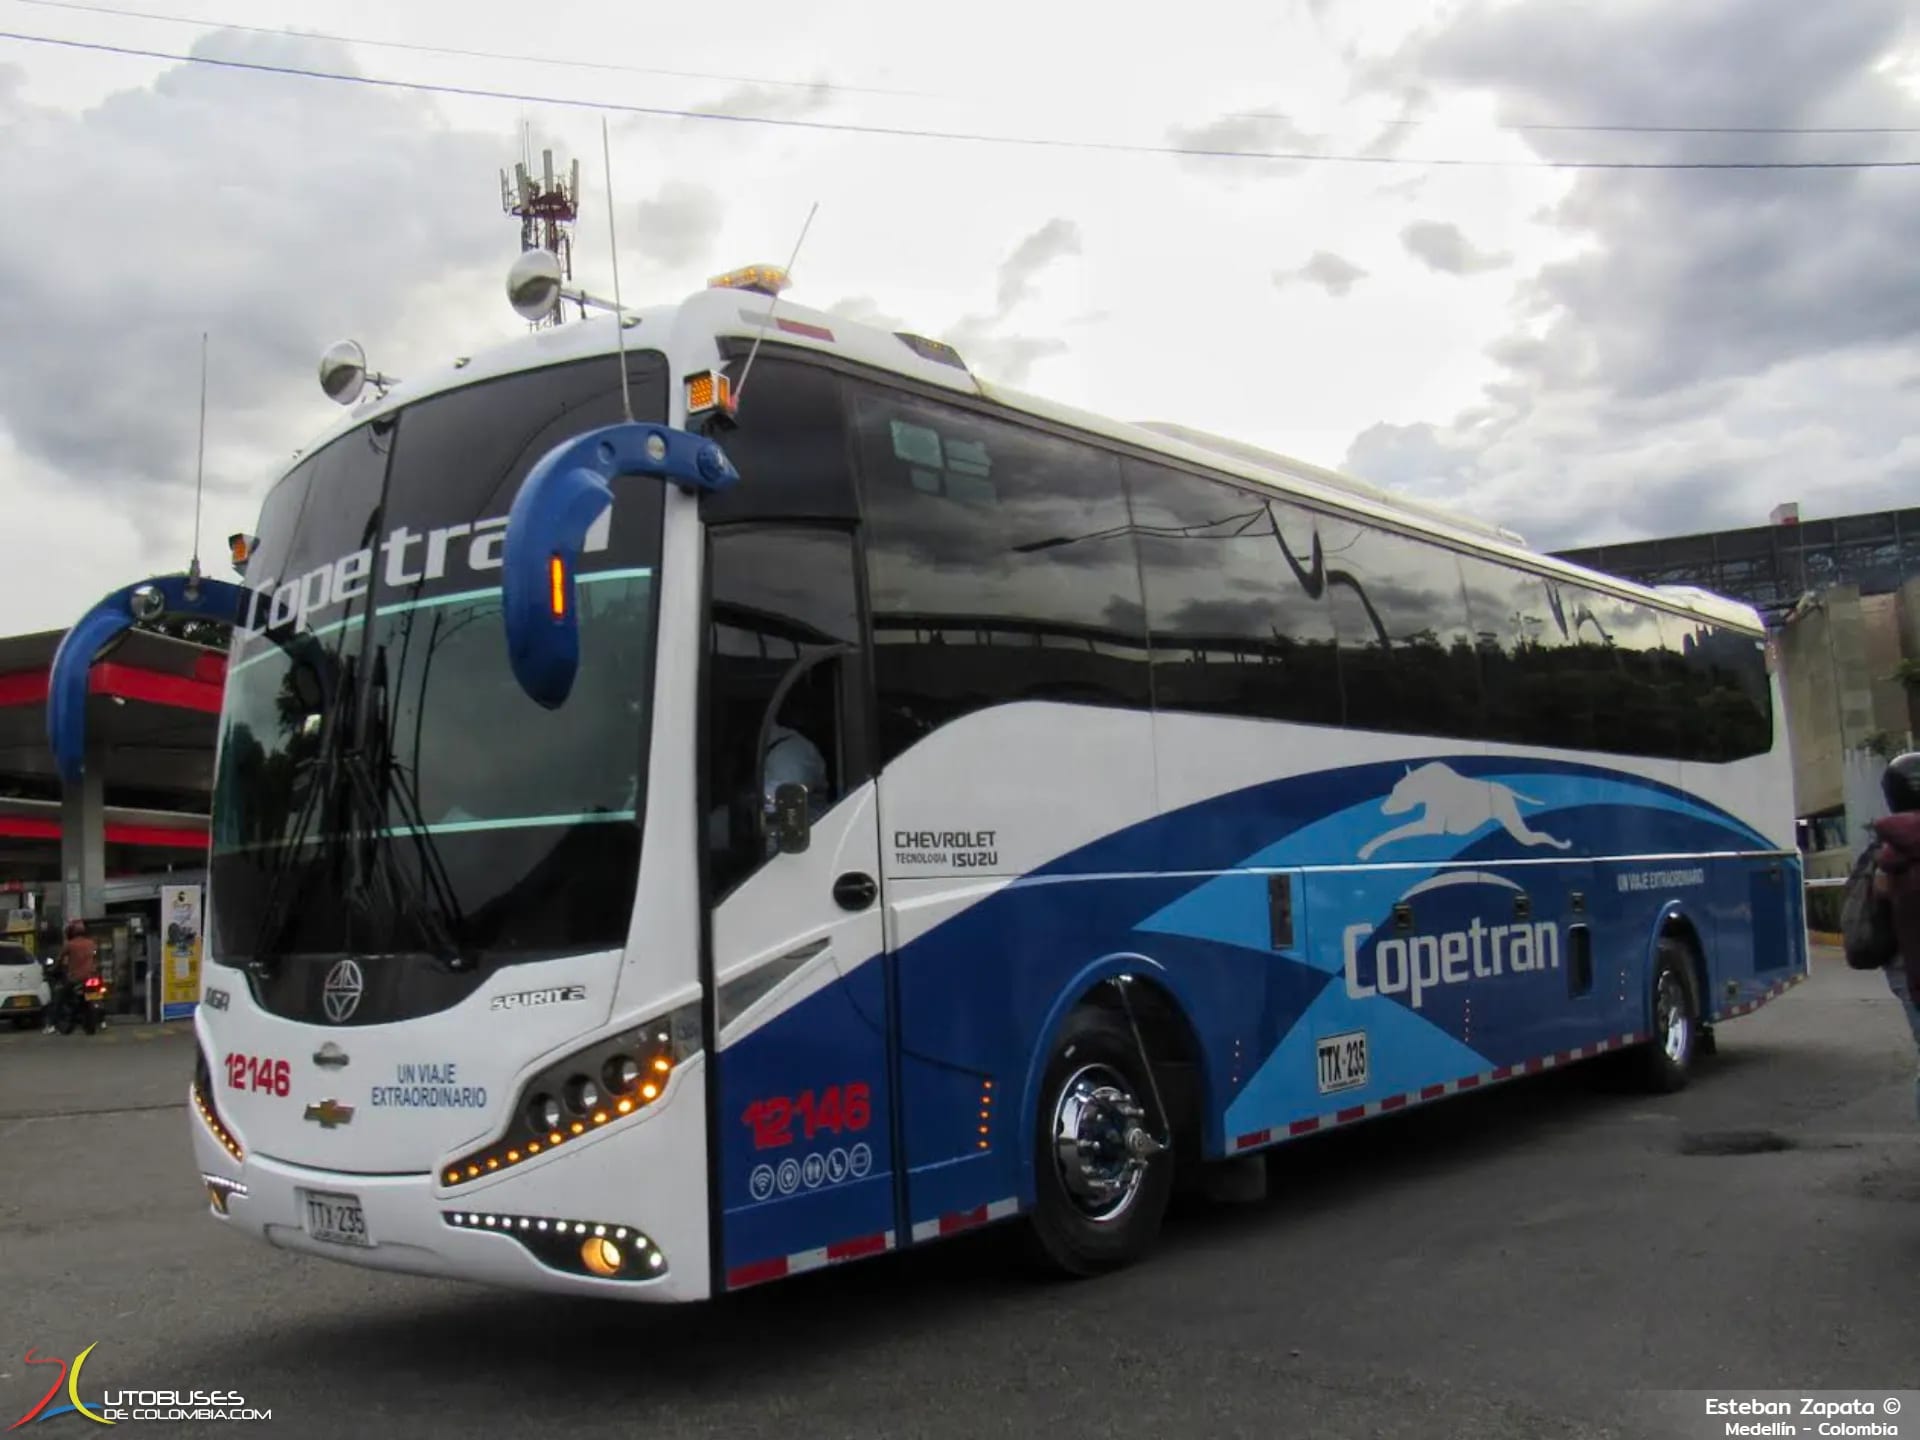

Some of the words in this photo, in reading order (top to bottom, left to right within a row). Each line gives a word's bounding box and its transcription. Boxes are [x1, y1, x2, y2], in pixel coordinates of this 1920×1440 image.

[244, 503, 613, 638] Copetra
[894, 830, 996, 849] CHEVROLET
[951, 850, 998, 868] ISUZU
[1343, 916, 1559, 1009] Copetran
[224, 1051, 291, 1098] 12146
[396, 1063, 416, 1085] UN
[417, 1063, 457, 1085] VIAJE
[370, 1085, 488, 1109] EXTRAORDINARIO
[740, 1080, 872, 1150] 12146
